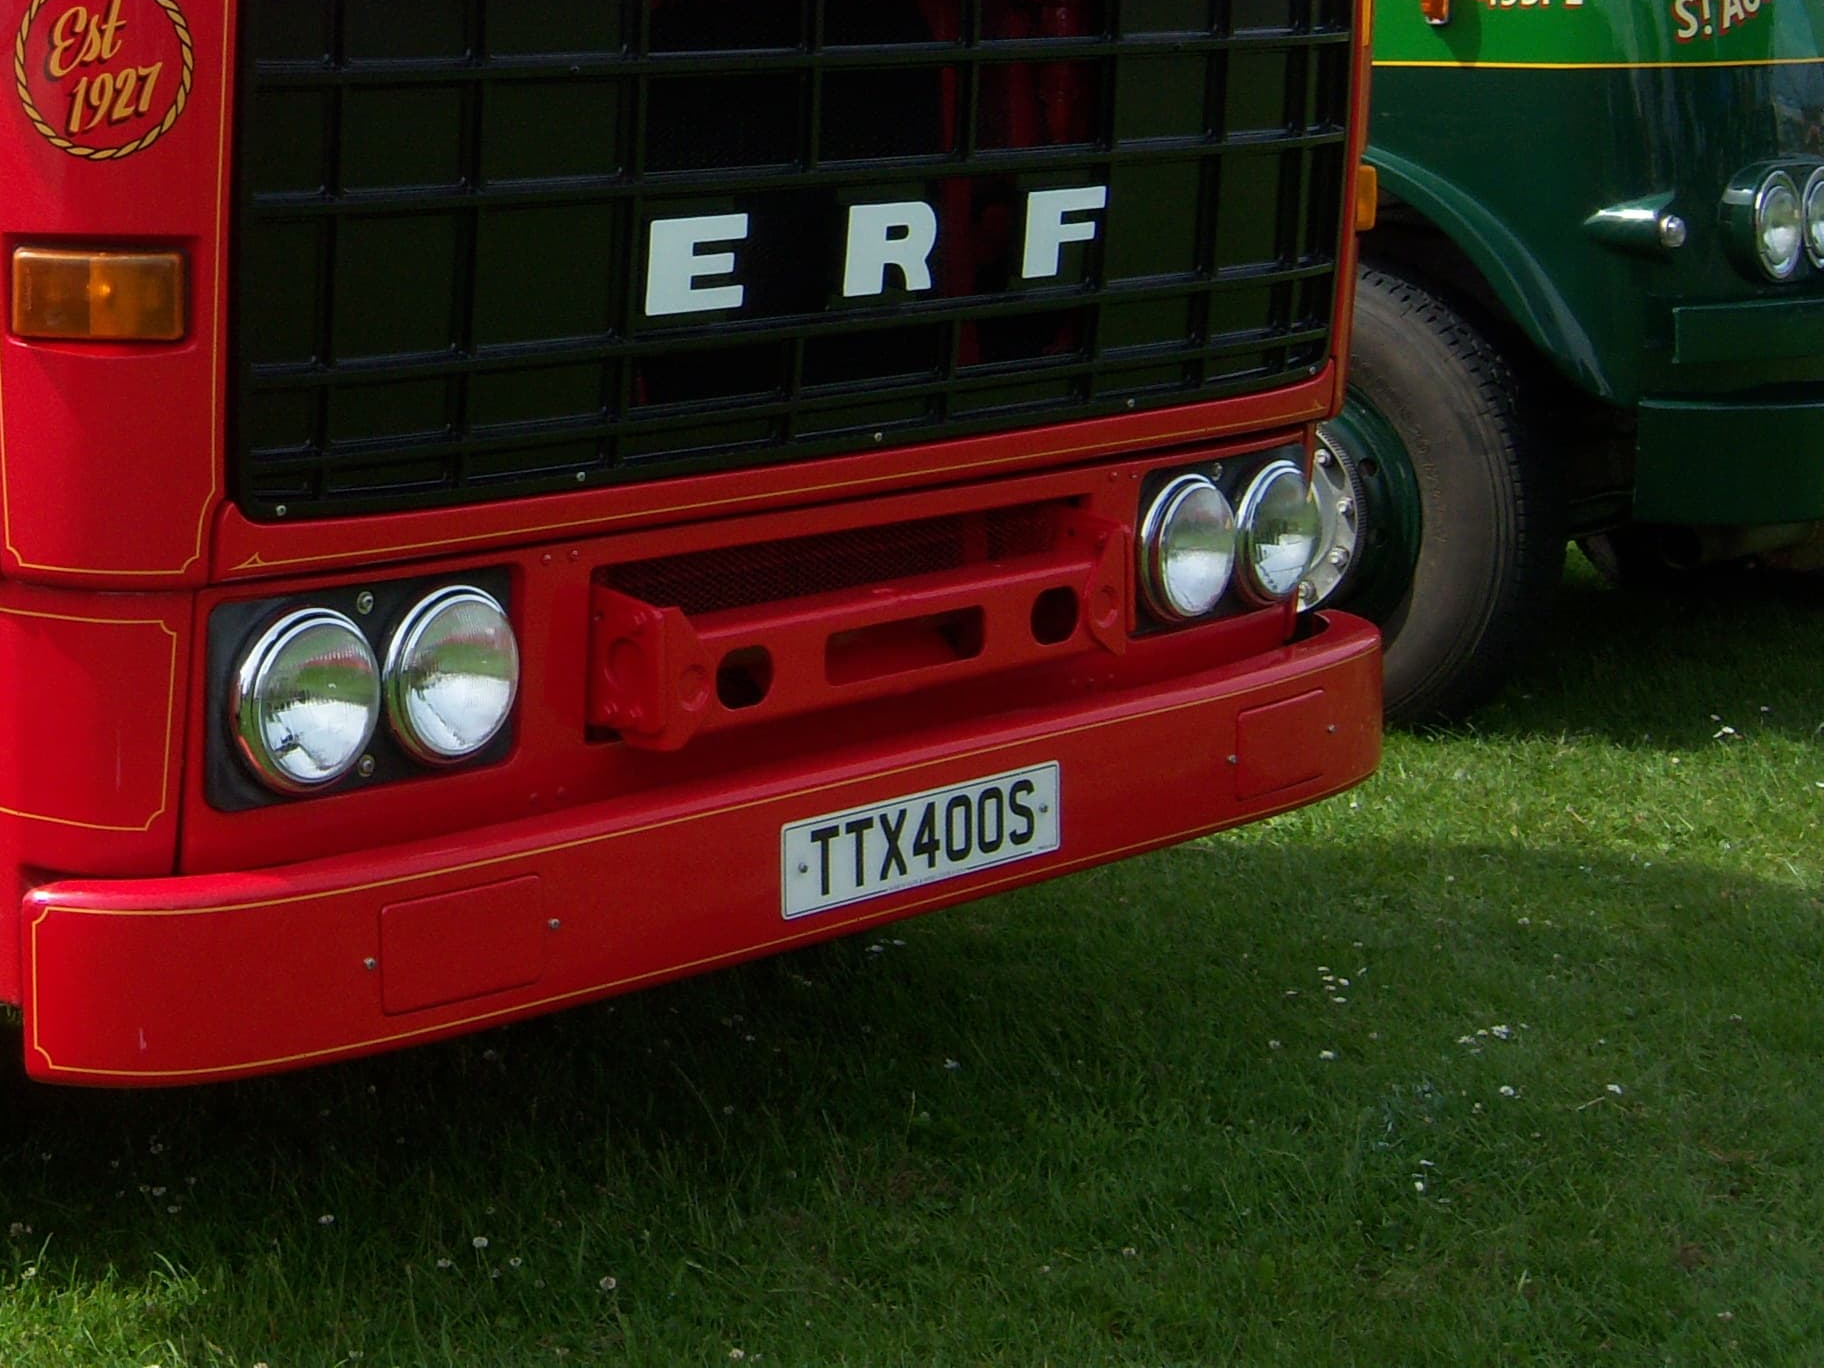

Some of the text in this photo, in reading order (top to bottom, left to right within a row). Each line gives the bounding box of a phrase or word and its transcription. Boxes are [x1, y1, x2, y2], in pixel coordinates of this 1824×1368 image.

[67, 60, 163, 133] 1927
[644, 185, 1108, 317] ERF
[810, 778, 1035, 897] TTX400S
